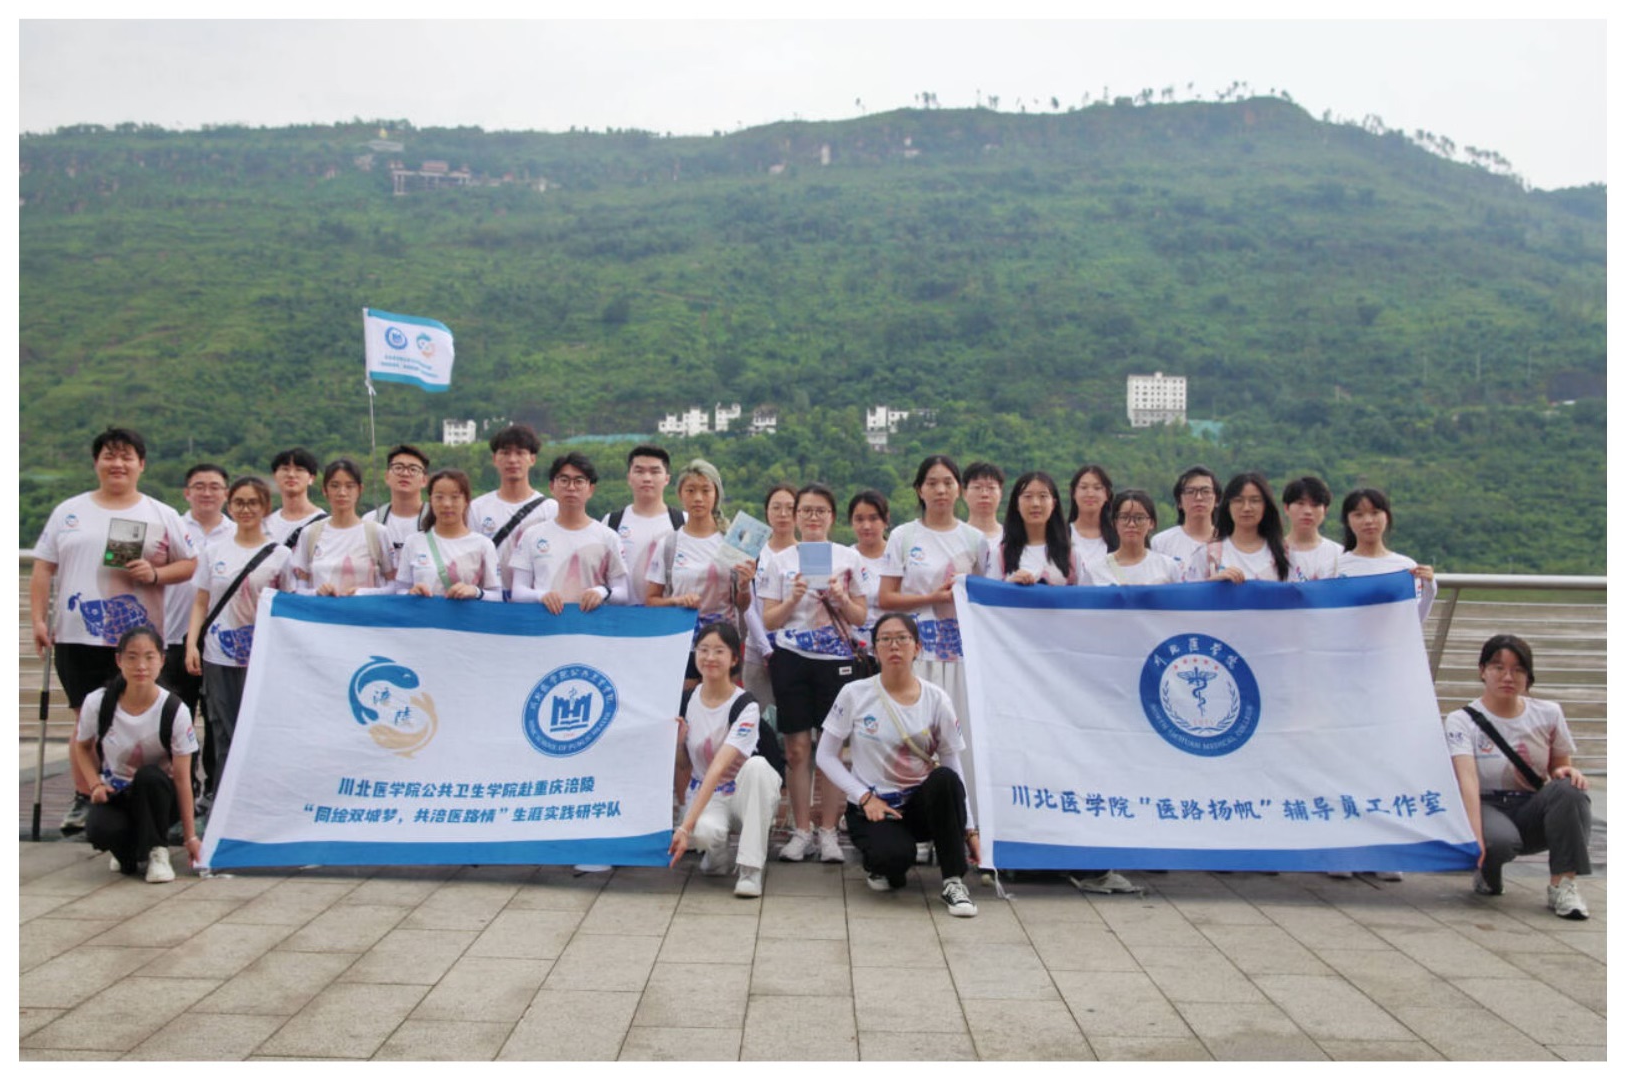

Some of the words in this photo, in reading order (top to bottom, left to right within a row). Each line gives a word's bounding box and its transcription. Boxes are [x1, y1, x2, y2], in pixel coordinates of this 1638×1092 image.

[337, 776, 595, 800] 川北医学院公共卫生学院赴重庆涪陵
